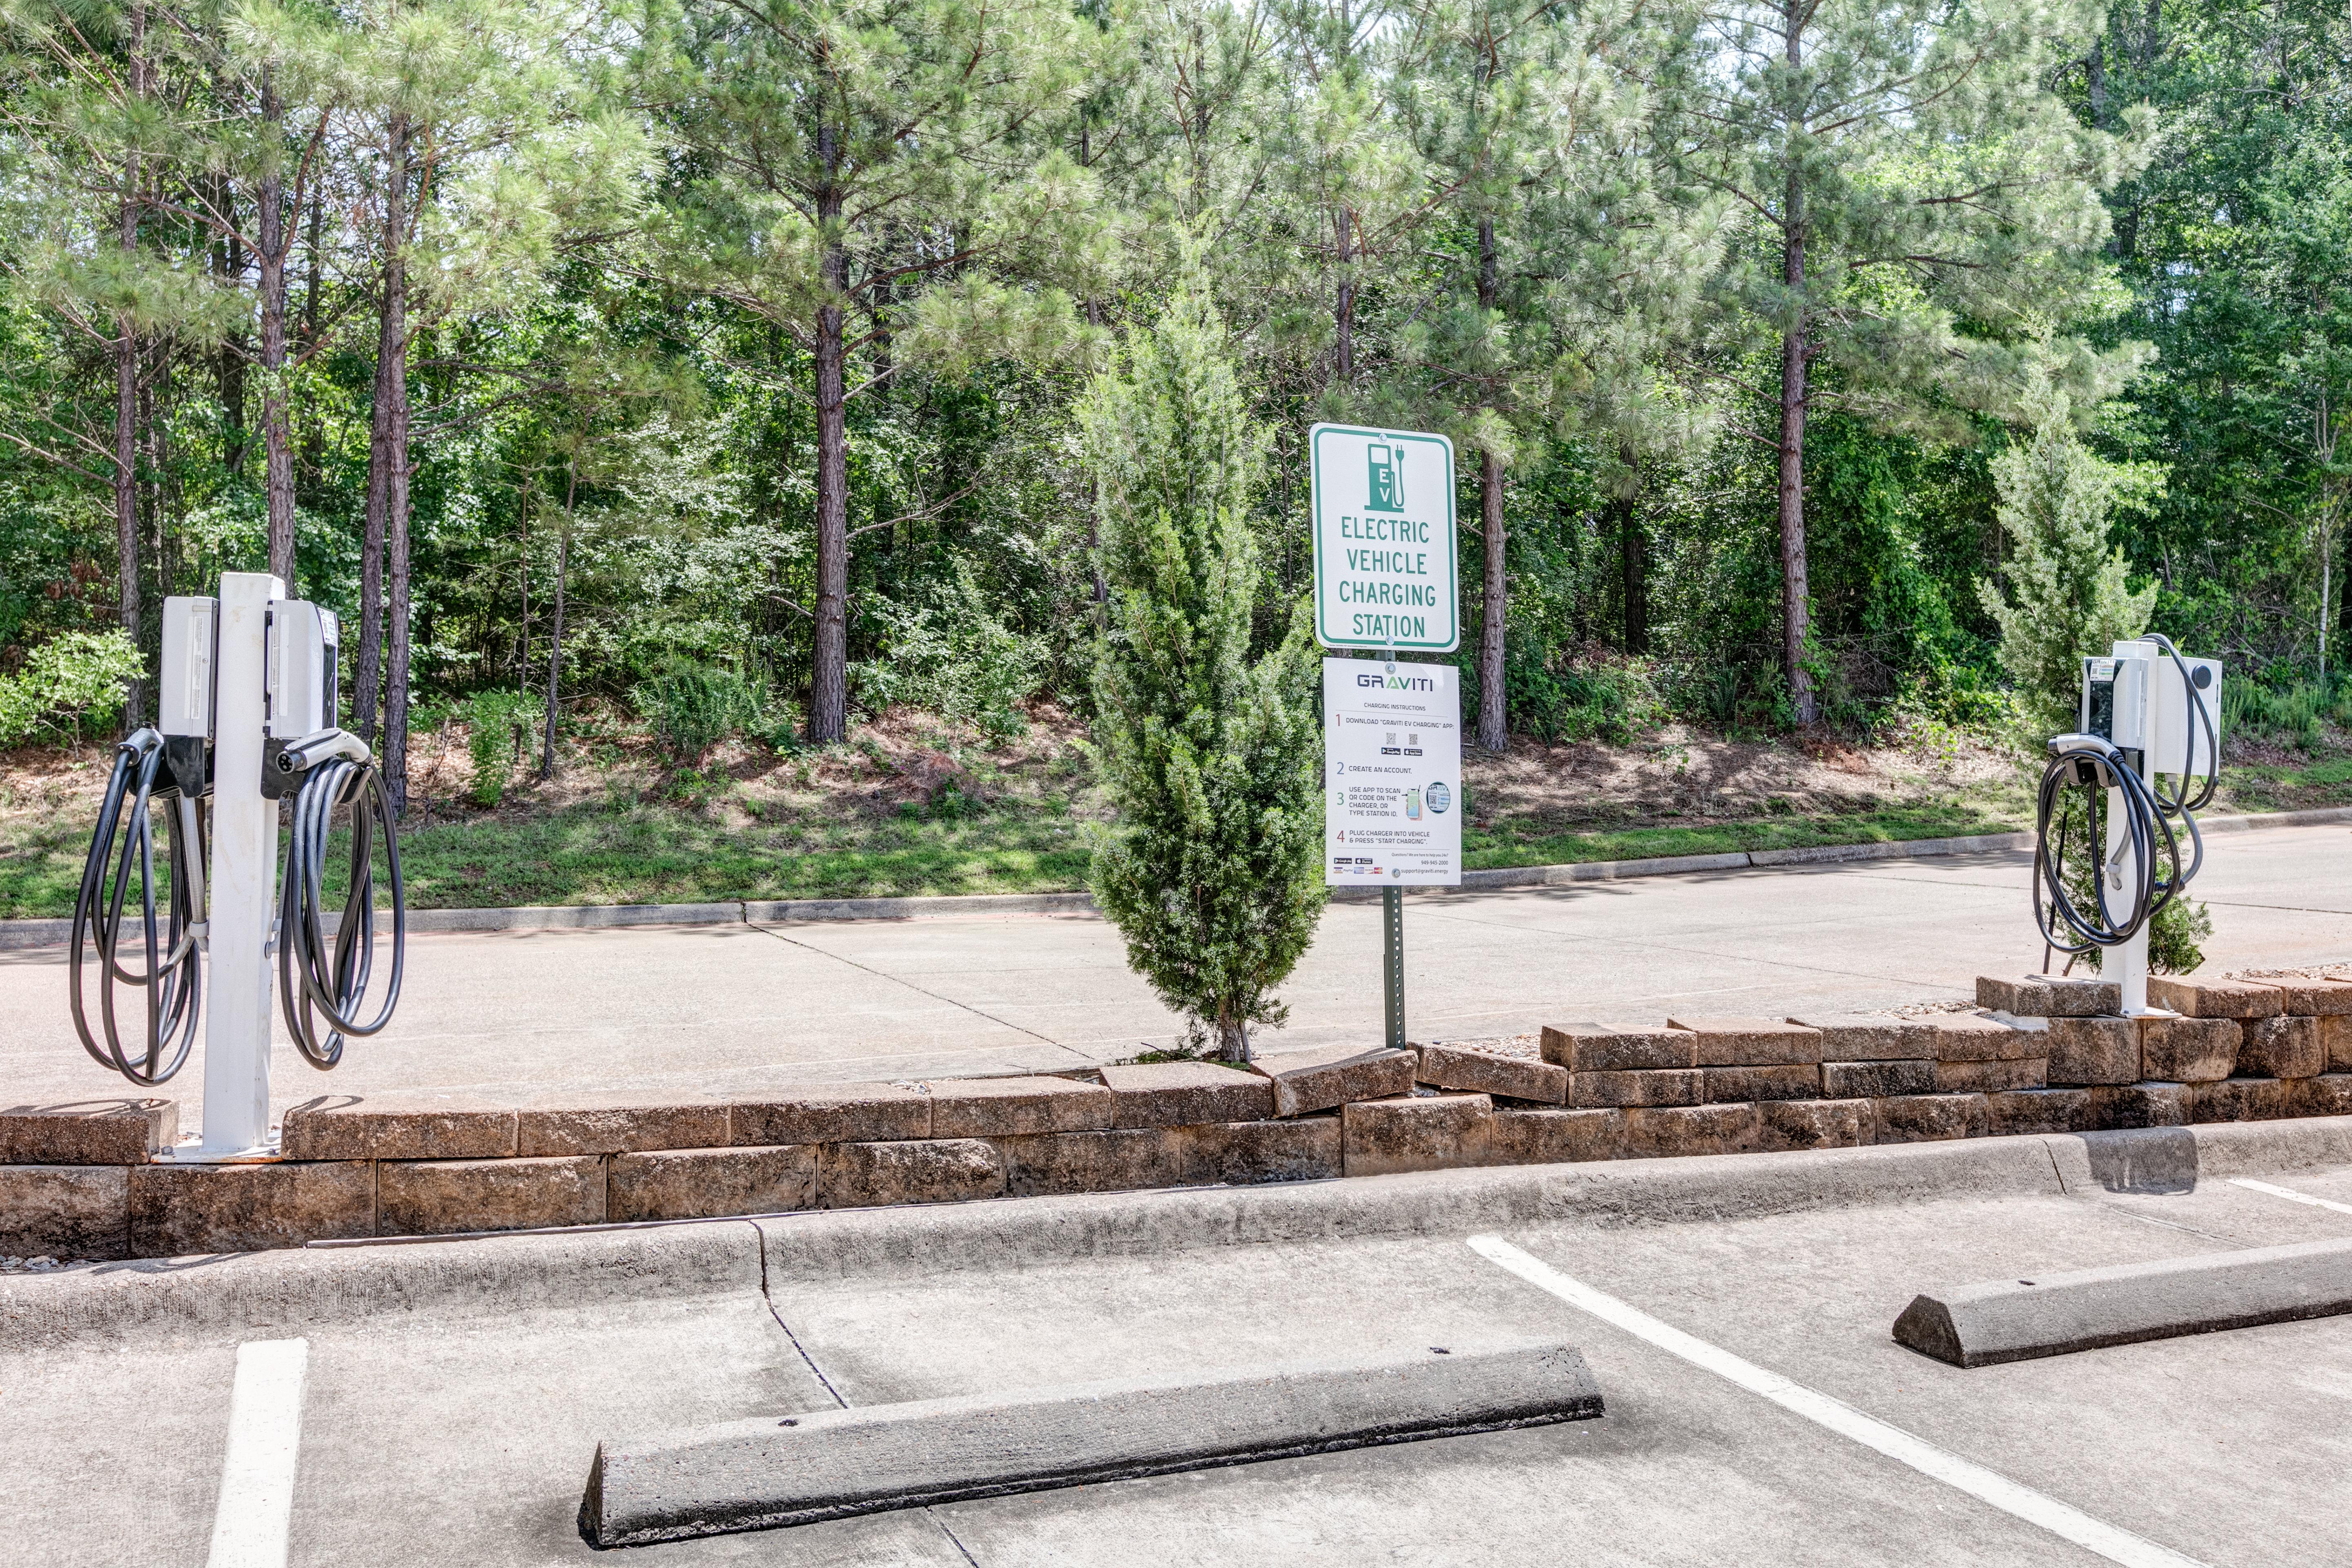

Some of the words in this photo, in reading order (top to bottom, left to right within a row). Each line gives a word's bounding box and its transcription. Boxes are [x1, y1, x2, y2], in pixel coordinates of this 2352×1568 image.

[1379, 468, 1390, 502] EV
[1341, 516, 1430, 543] ELECTRIC
[1346, 548, 1427, 575] VEHICLE
[1339, 580, 1436, 607] CHARGING
[1353, 613, 1425, 637] STATION
[1357, 674, 1433, 692] GRAVITI
[1336, 714, 1340, 726] 1
[1337, 762, 1344, 775] 2
[1337, 792, 1344, 805] 3
[1337, 830, 1345, 843] 4
